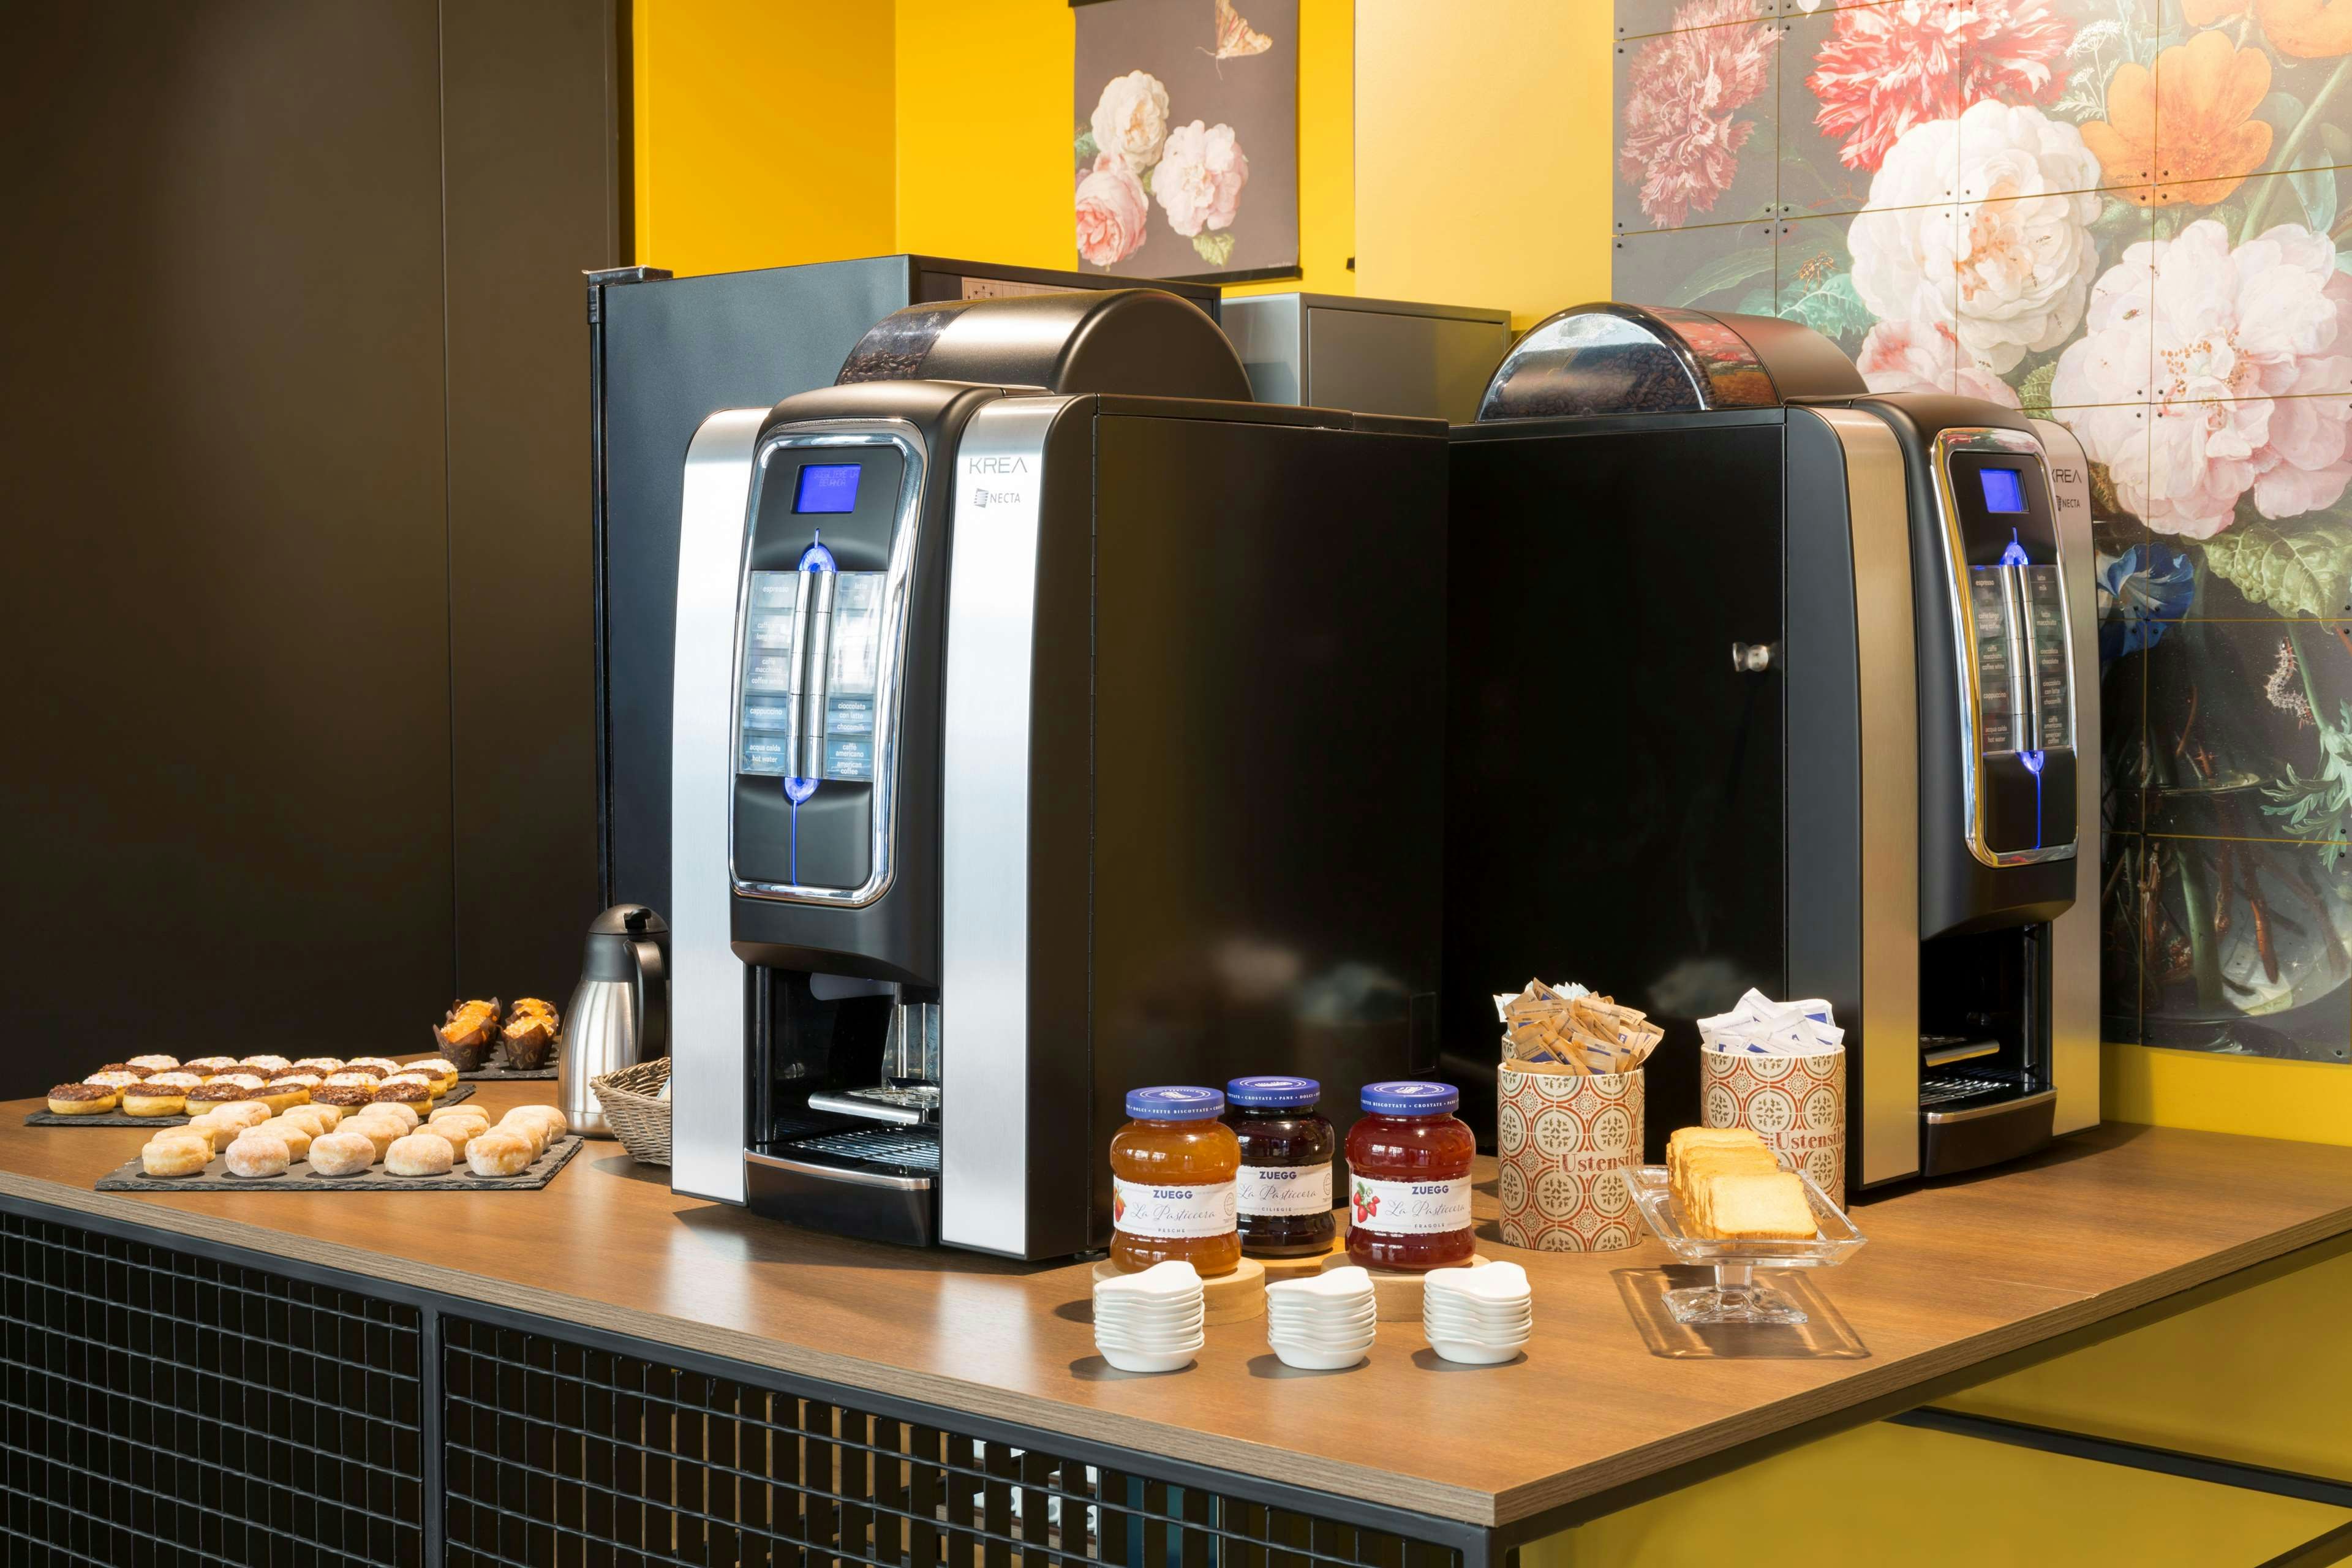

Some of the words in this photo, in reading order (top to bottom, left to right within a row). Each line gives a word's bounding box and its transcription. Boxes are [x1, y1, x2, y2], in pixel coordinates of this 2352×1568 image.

[970, 457, 1028, 474] KREA
[990, 492, 1020, 503] NECTA
[2062, 499, 2081, 508] NECTA
[750, 707, 782, 716] cappuccino
[1259, 1171, 1297, 1180] ZUEGG
[1153, 1189, 1193, 1199] ZUEGG
[1238, 1183, 1254, 1199] La
[1259, 1184, 1316, 1200] Pasticcera
[1412, 1185, 1449, 1194] ZUEGG
[1131, 1202, 1148, 1219] La
[1153, 1203, 1216, 1221] Pasticcera
[1385, 1199, 1406, 1216] La
[1412, 1200, 1465, 1217] Pasticcera
